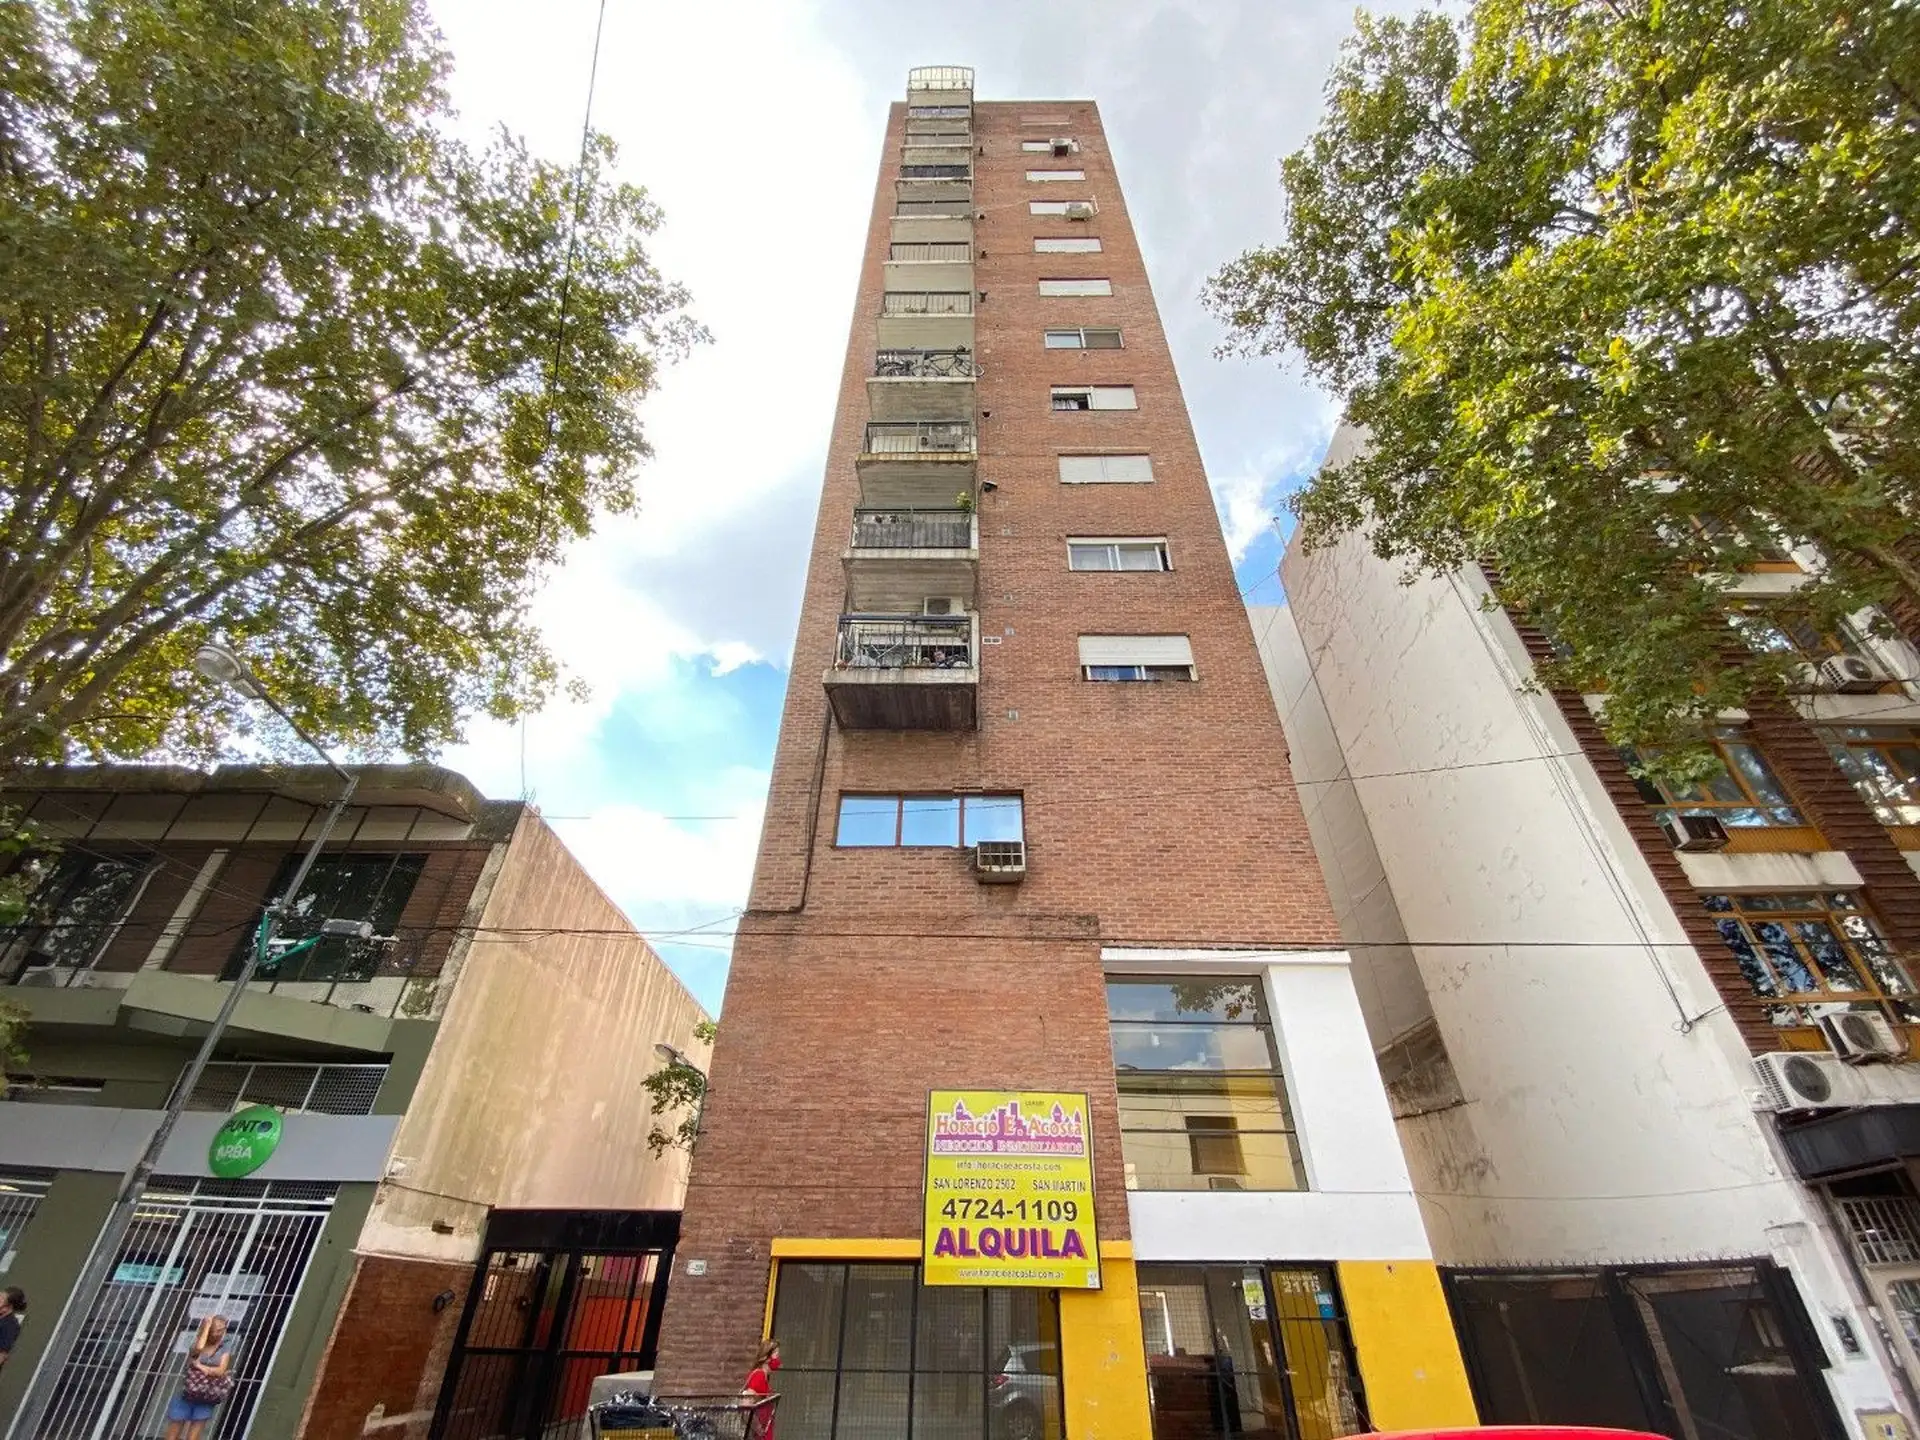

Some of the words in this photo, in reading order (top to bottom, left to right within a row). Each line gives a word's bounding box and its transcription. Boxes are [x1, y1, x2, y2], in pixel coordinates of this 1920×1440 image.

[221, 1120, 273, 1133] PUNTO
[935, 1115, 999, 1136] Horacio
[1028, 1117, 1082, 1137] Acosta
[933, 1178, 950, 1190] SAN
[953, 1178, 993, 1190] LORENZO
[1032, 1180, 1050, 1191] SAN
[1052, 1180, 1086, 1192] MARTIN
[942, 1198, 1078, 1222] 4724-1109
[933, 1227, 1088, 1261] ALQUILA
